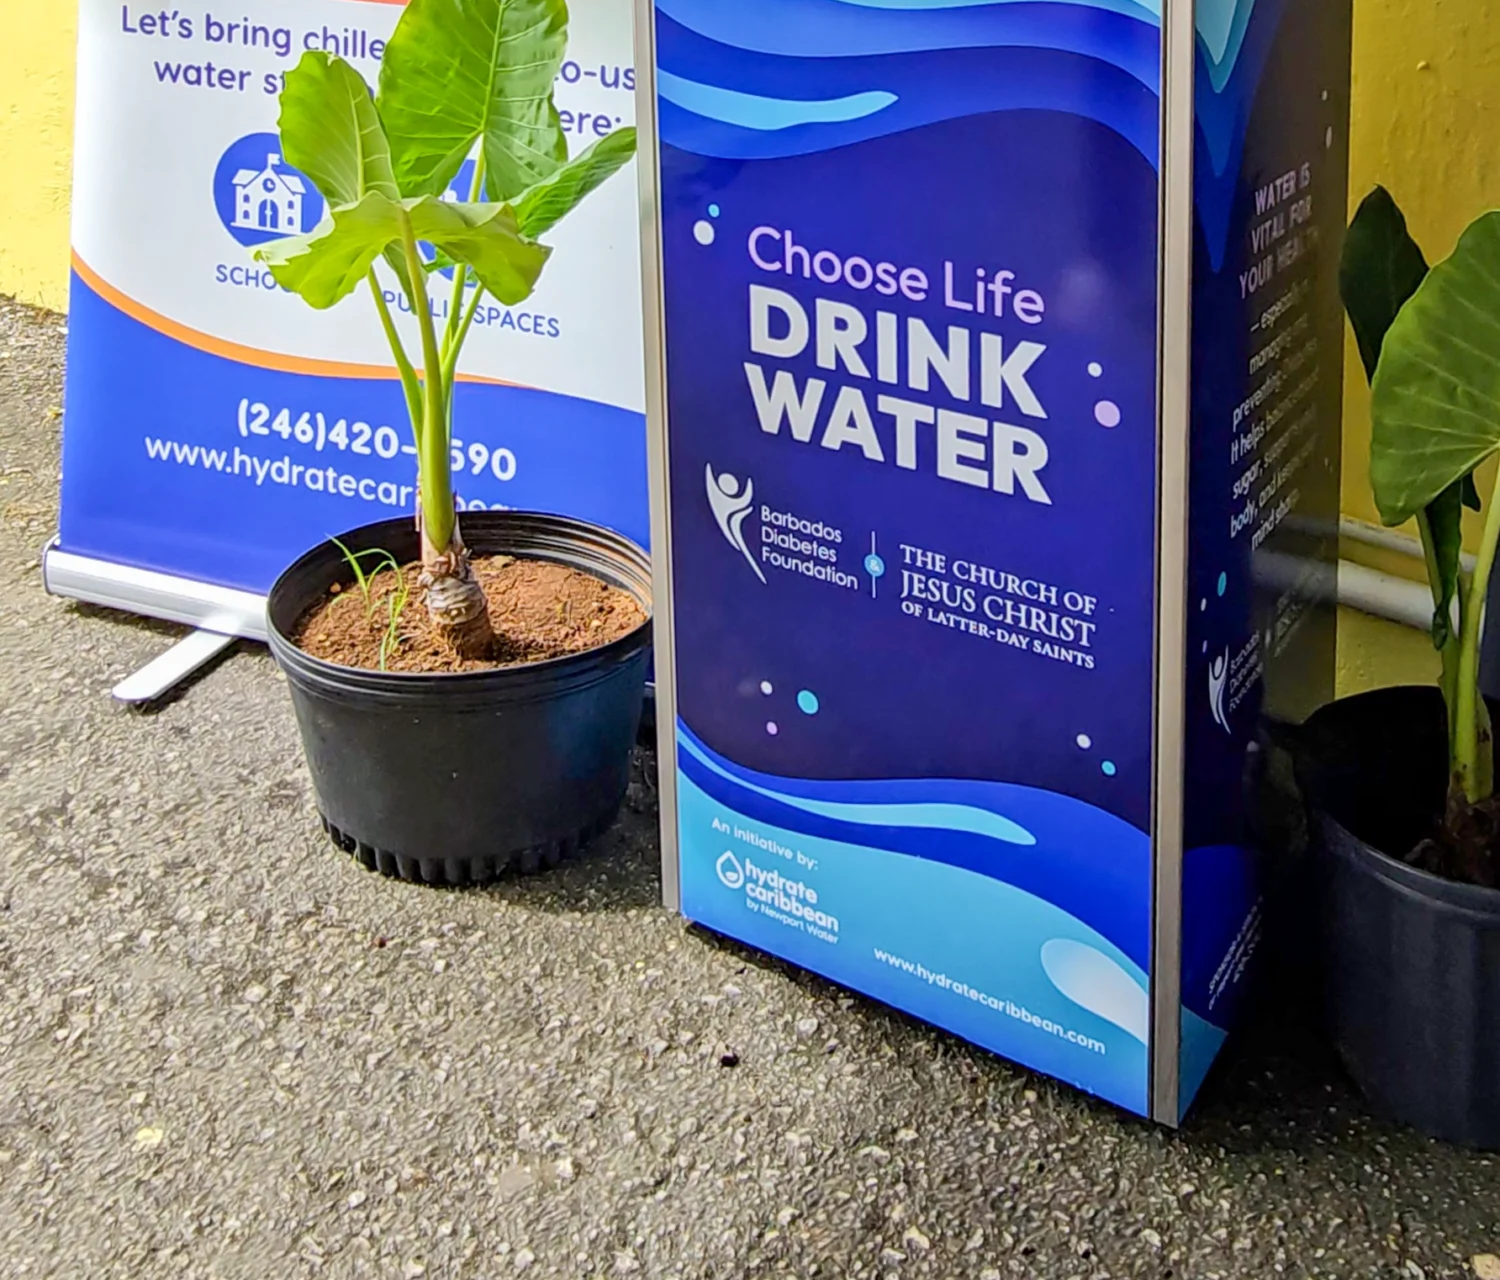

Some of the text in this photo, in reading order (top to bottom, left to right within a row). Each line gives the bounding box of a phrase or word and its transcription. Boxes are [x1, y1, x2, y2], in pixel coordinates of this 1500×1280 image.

[121, 5, 194, 39] Let's
[205, 13, 291, 57] bring
[303, 25, 387, 61] chille
[154, 60, 252, 91] water
[1254, 169, 1297, 216] WATER
[216, 263, 293, 293] SCHO
[747, 225, 1045, 324] Choose Life
[1239, 254, 1273, 300] YOUR
[382, 290, 560, 338] PULI SPACES
[749, 284, 1048, 419] DRINK
[238, 398, 518, 482] (246)420-590
[743, 361, 1052, 505] WATER
[761, 505, 842, 543] Barbados
[761, 525, 837, 562] Diabetes
[762, 546, 858, 590] Foundation
[900, 544, 1097, 616] THE CHURCH OF
[900, 569, 1096, 647] JESUS CHRIST
[901, 601, 1095, 669] OF LATTER-DAY SAINTS
[712, 817, 730, 834] An
[734, 825, 793, 860] initiative
[745, 858, 818, 904] hydrate
[745, 882, 839, 932] caribbean
[761, 903, 804, 931] Newport
[806, 922, 839, 944] Water
[874, 947, 1106, 1054] www.hydratecaribbean.com
